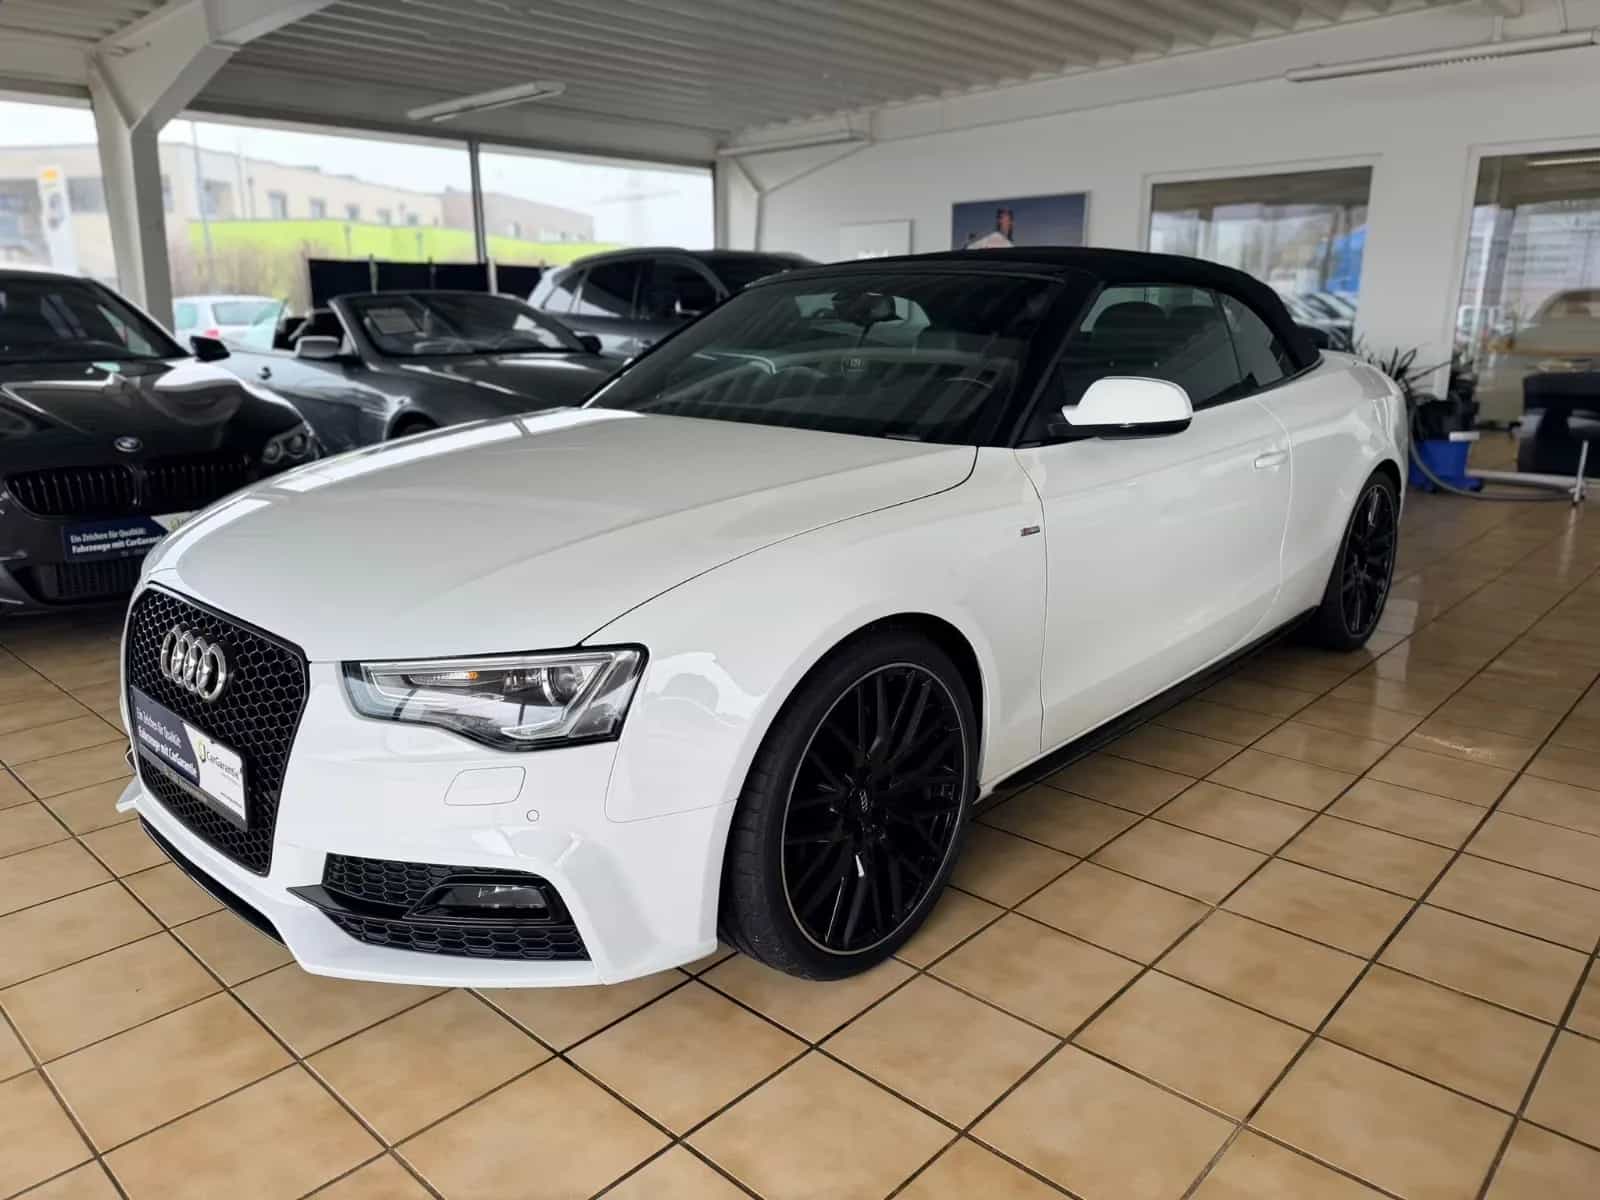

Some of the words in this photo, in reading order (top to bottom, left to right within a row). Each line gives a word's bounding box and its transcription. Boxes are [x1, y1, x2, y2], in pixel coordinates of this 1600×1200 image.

[70, 534, 81, 543] Ein
[82, 531, 107, 543] Zeichen
[108, 529, 118, 538] für
[72, 542, 111, 554] Fahrzeuge
[112, 540, 125, 549] mit
